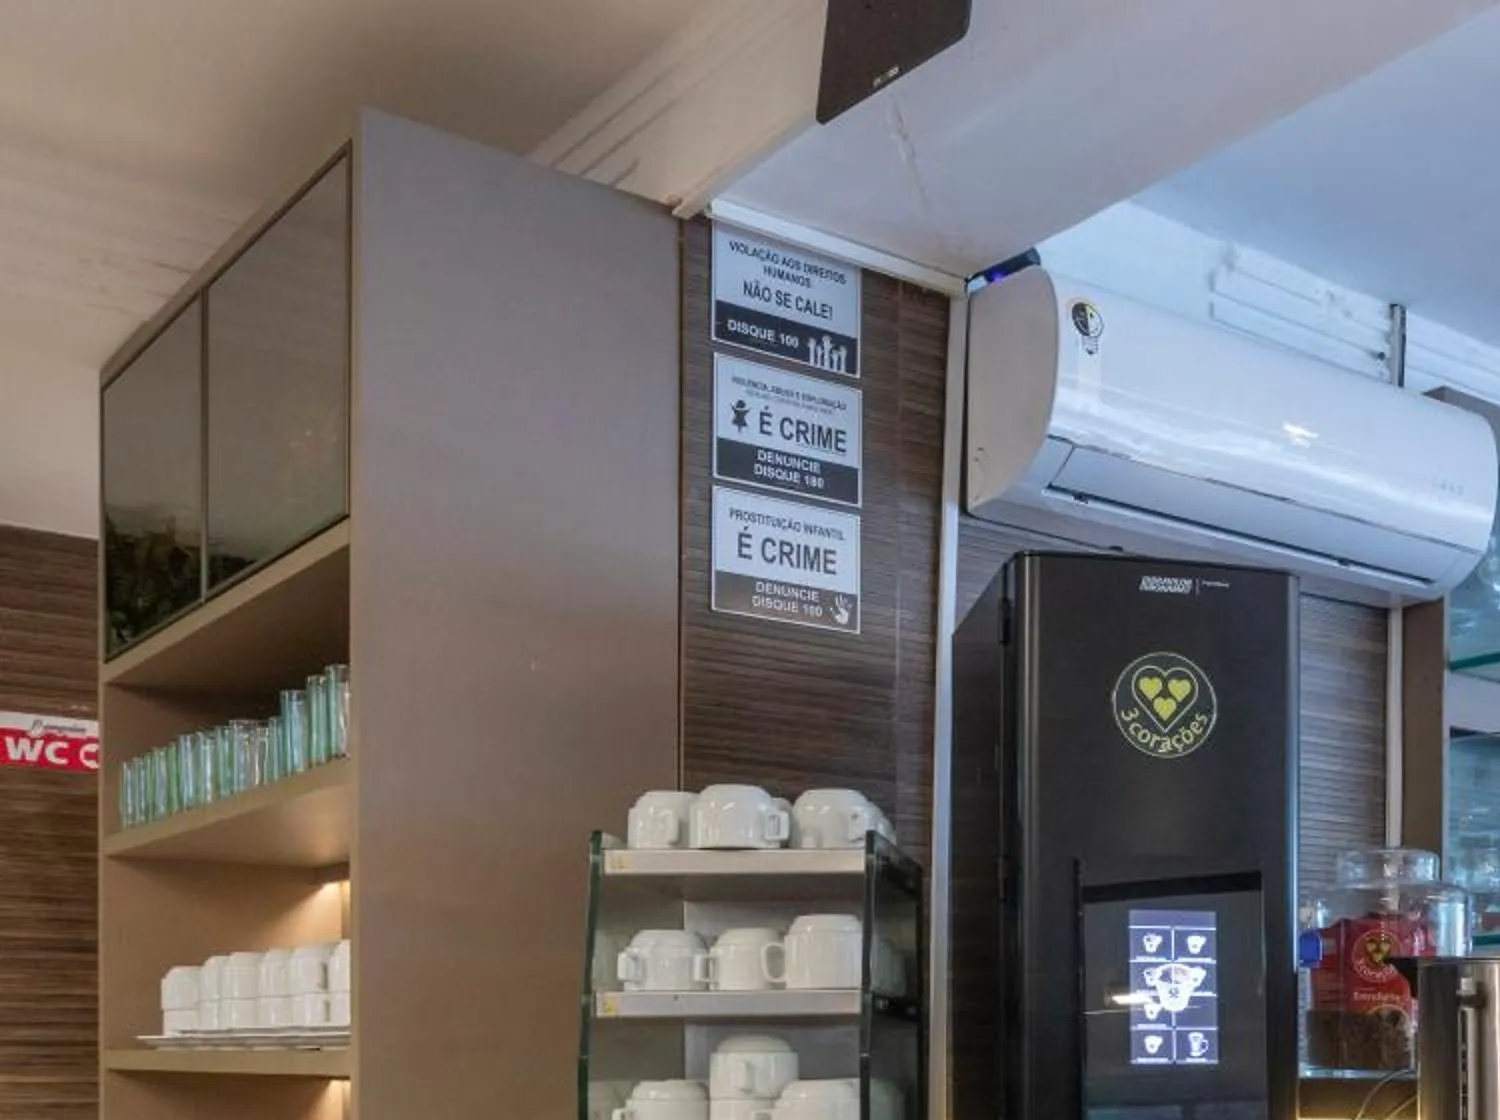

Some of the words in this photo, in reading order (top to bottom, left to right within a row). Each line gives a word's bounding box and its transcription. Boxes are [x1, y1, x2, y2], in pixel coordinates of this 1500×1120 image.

[763, 265, 811, 288] HUMANOS
[781, 257, 801, 270] AOS
[743, 279, 772, 303] NÃO
[775, 289, 793, 308] SE
[727, 319, 777, 340] DISQUE
[780, 334, 799, 348] 100
[759, 406, 773, 435] É
[780, 417, 847, 453] CRIME
[754, 463, 800, 484] DISQUE
[757, 450, 821, 473] DENUNCIE
[729, 507, 801, 533] PROSTITUIÇÃO
[803, 523, 845, 540] INFANTIL
[738, 526, 752, 560] É
[761, 537, 837, 575] CRIME
[752, 595, 799, 613] DISQUE
[756, 581, 820, 602] DENUNCIE
[5, 736, 69, 765] WC
